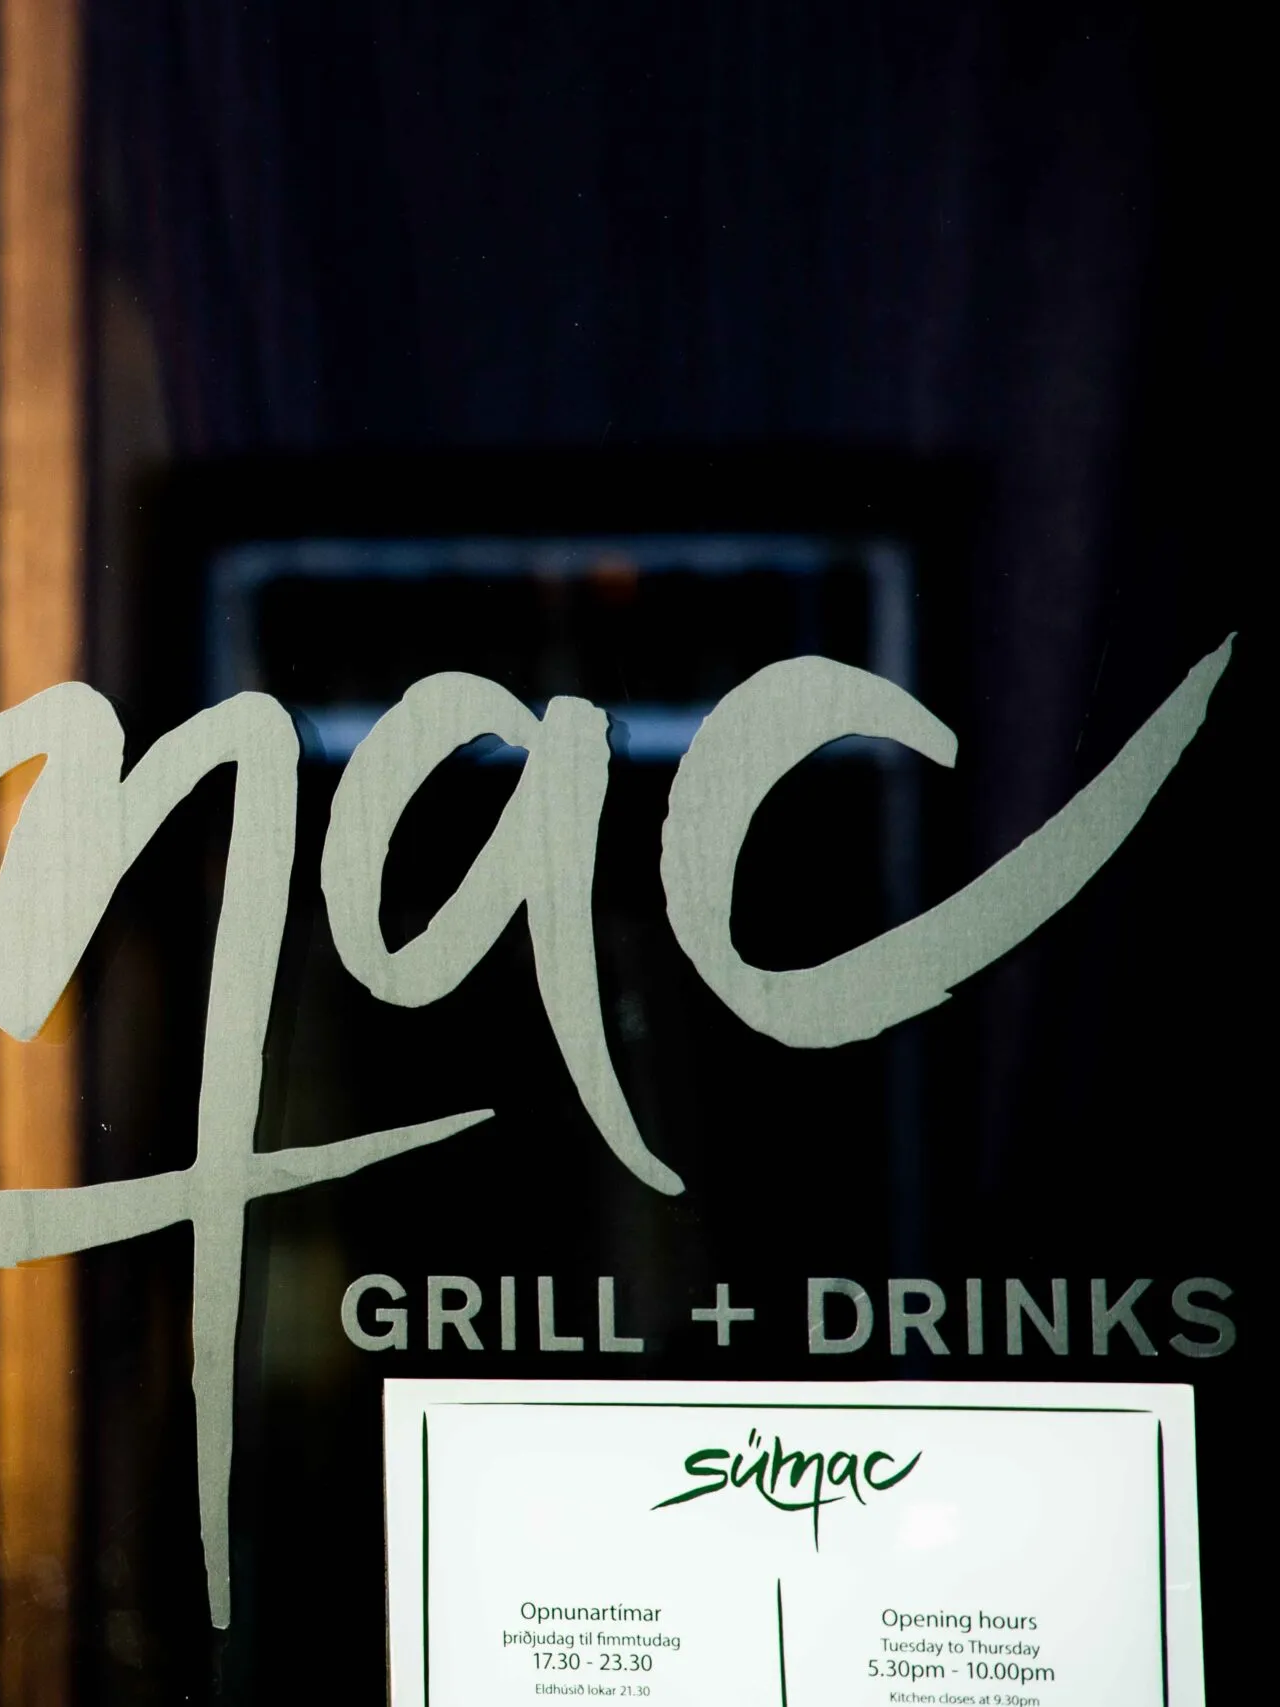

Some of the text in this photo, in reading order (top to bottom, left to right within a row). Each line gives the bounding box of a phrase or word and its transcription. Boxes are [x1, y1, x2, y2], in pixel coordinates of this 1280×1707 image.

[340, 1274, 1238, 1359] GRILL + DRINKS
[650, 1428, 923, 1553] sümac
[519, 1601, 663, 1625] Opnunartímar
[881, 1608, 1038, 1634] Opening hours
[502, 1630, 682, 1651] þriðjudag til fimmtudag
[880, 1637, 1042, 1660] Tuesday to Thursday
[532, 1652, 581, 1671] 17.30
[599, 1653, 653, 1673] 23.30
[867, 1659, 946, 1683] 5.30pm
[966, 1662, 1056, 1686] 10.00pm
[534, 1683, 651, 1698] Eldhúsið lokar 21.30
[889, 1691, 1041, 1707] Kitchen closes at 9.30pm
